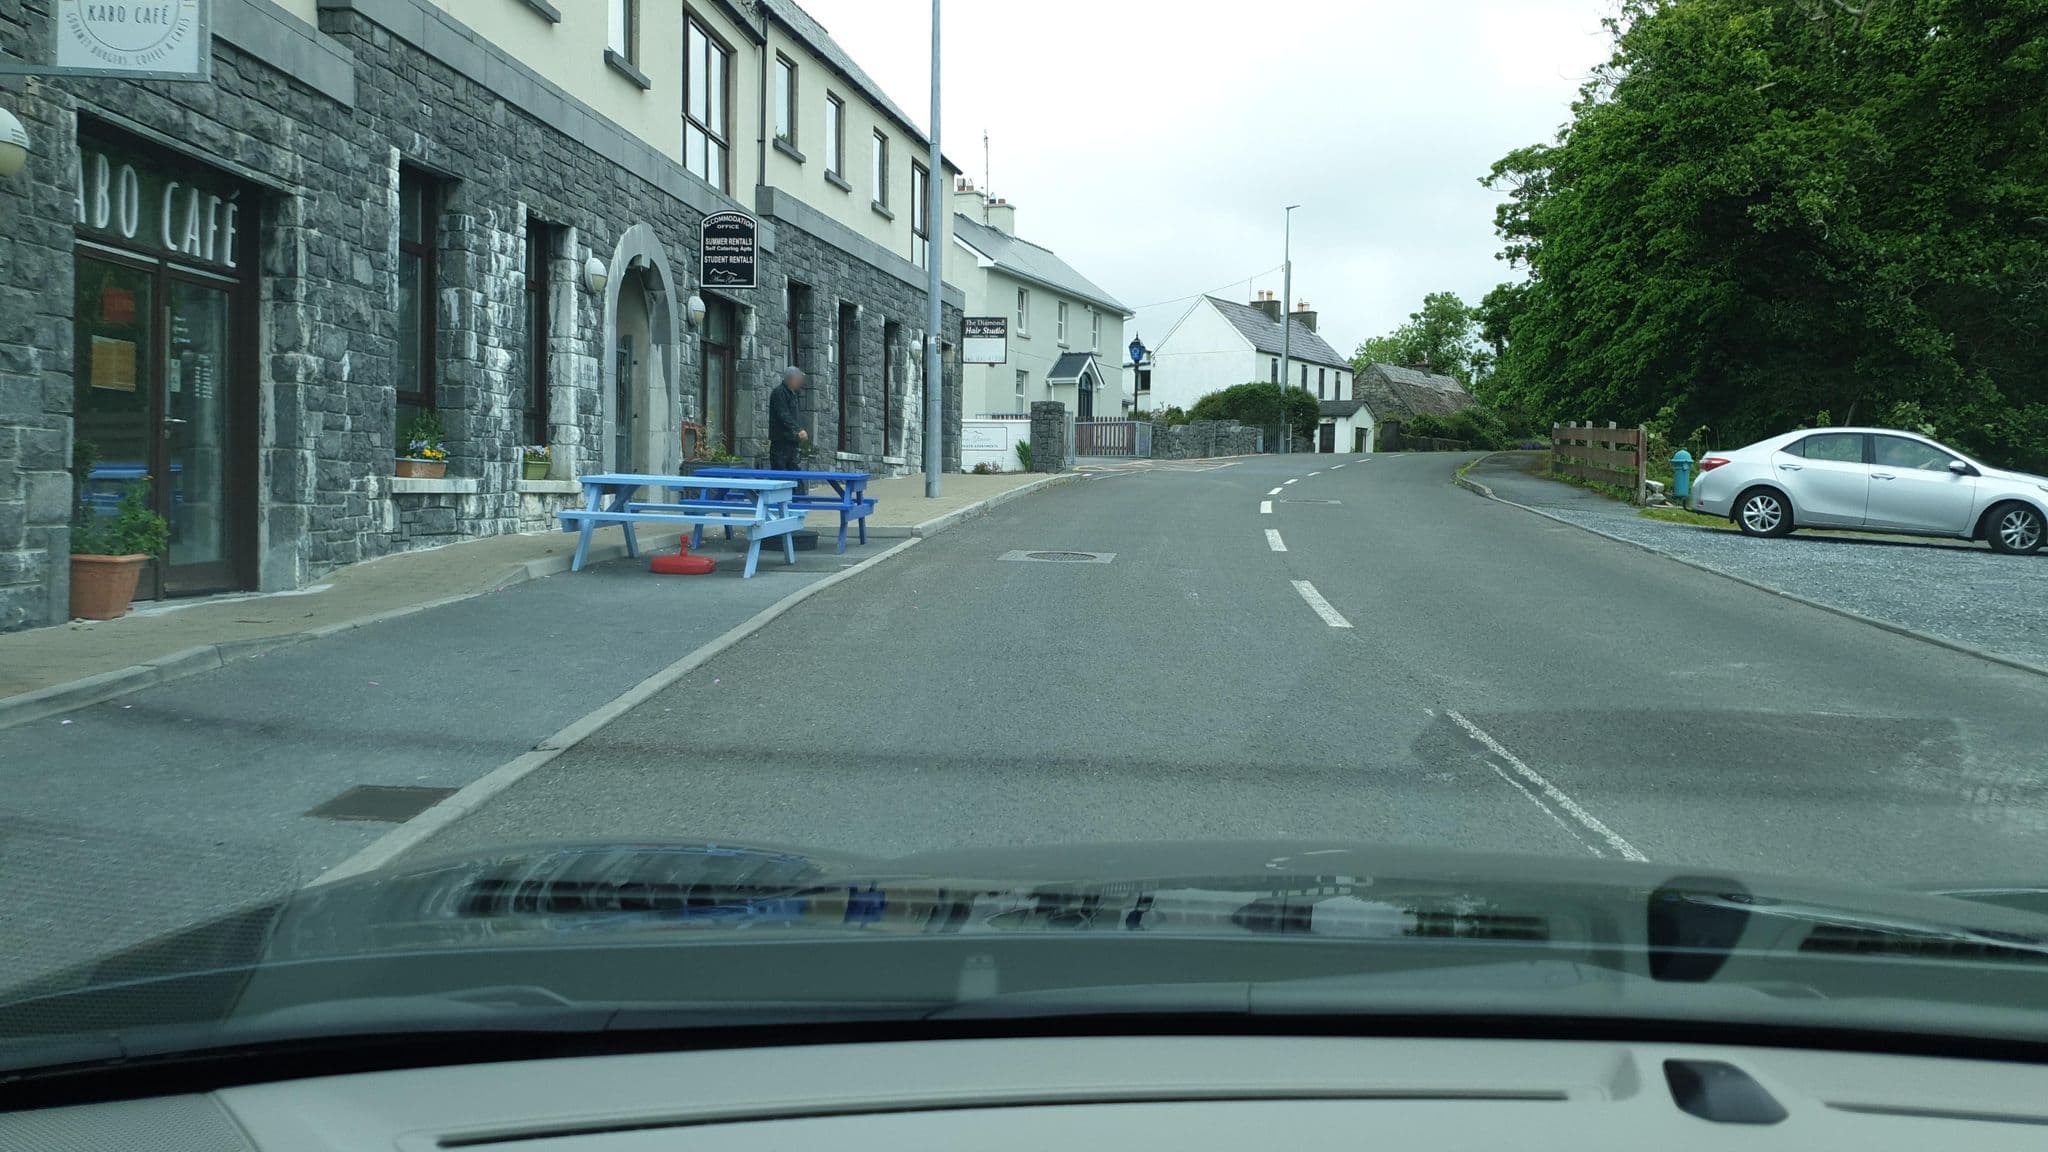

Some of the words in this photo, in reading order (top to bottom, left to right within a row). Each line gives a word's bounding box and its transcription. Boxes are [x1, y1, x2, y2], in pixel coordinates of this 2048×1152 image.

[88, 4, 126, 23] KABO
[134, 4, 170, 25] CAFÉ
[162, 181, 241, 269] CAFÉ
[703, 215, 755, 230] ACCOMMODATION
[705, 237, 728, 246] SUMMER
[728, 237, 753, 246] RENTALS
[704, 255, 729, 264] STUDENT
[729, 255, 753, 264] RENTALS
[965, 326, 982, 335] Hair
[982, 326, 1005, 335] Studio
